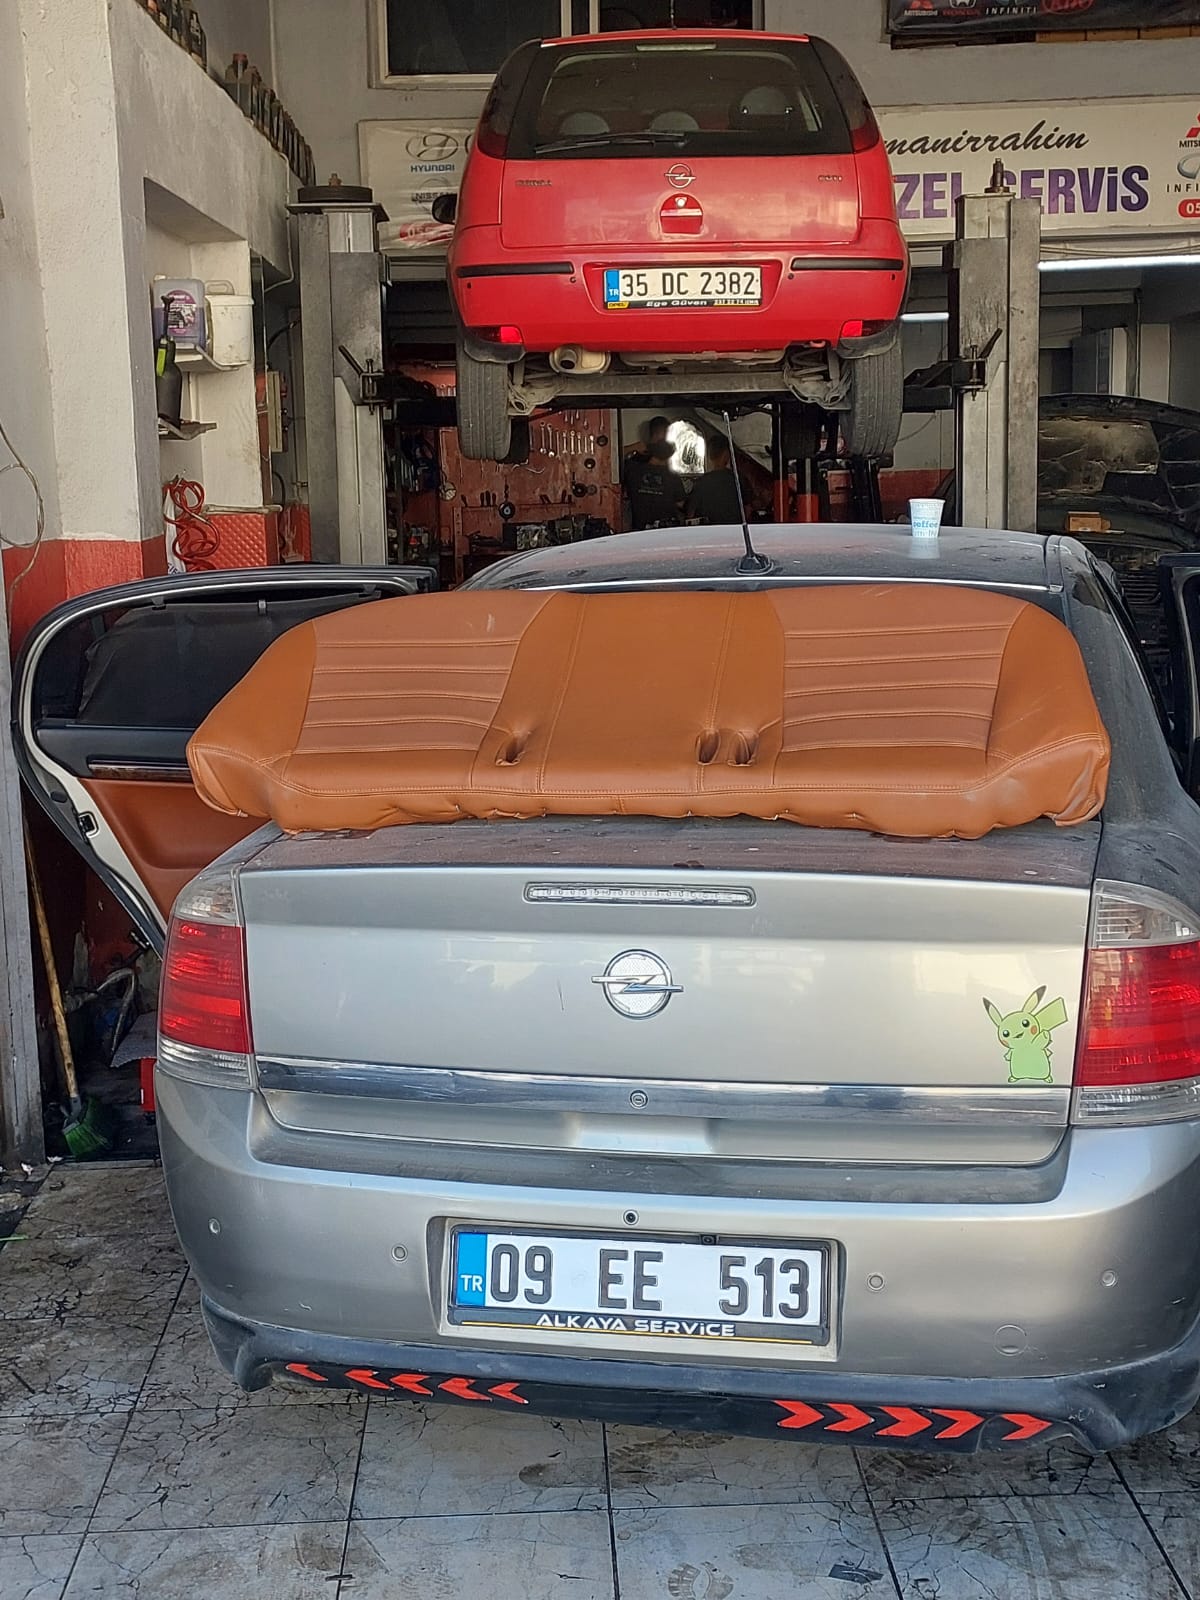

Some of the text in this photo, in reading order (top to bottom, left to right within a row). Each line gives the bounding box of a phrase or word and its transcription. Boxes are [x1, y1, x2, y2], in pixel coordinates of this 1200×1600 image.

[985, 6, 1036, 15] INFINITI
[410, 164, 455, 172] HYUNDAI
[622, 274, 648, 297] 35
[662, 272, 689, 296] DC
[700, 271, 755, 296] 2382
[460, 1243, 810, 1319] TR 09 EE 513
[535, 1313, 627, 1331] ALKAYA
